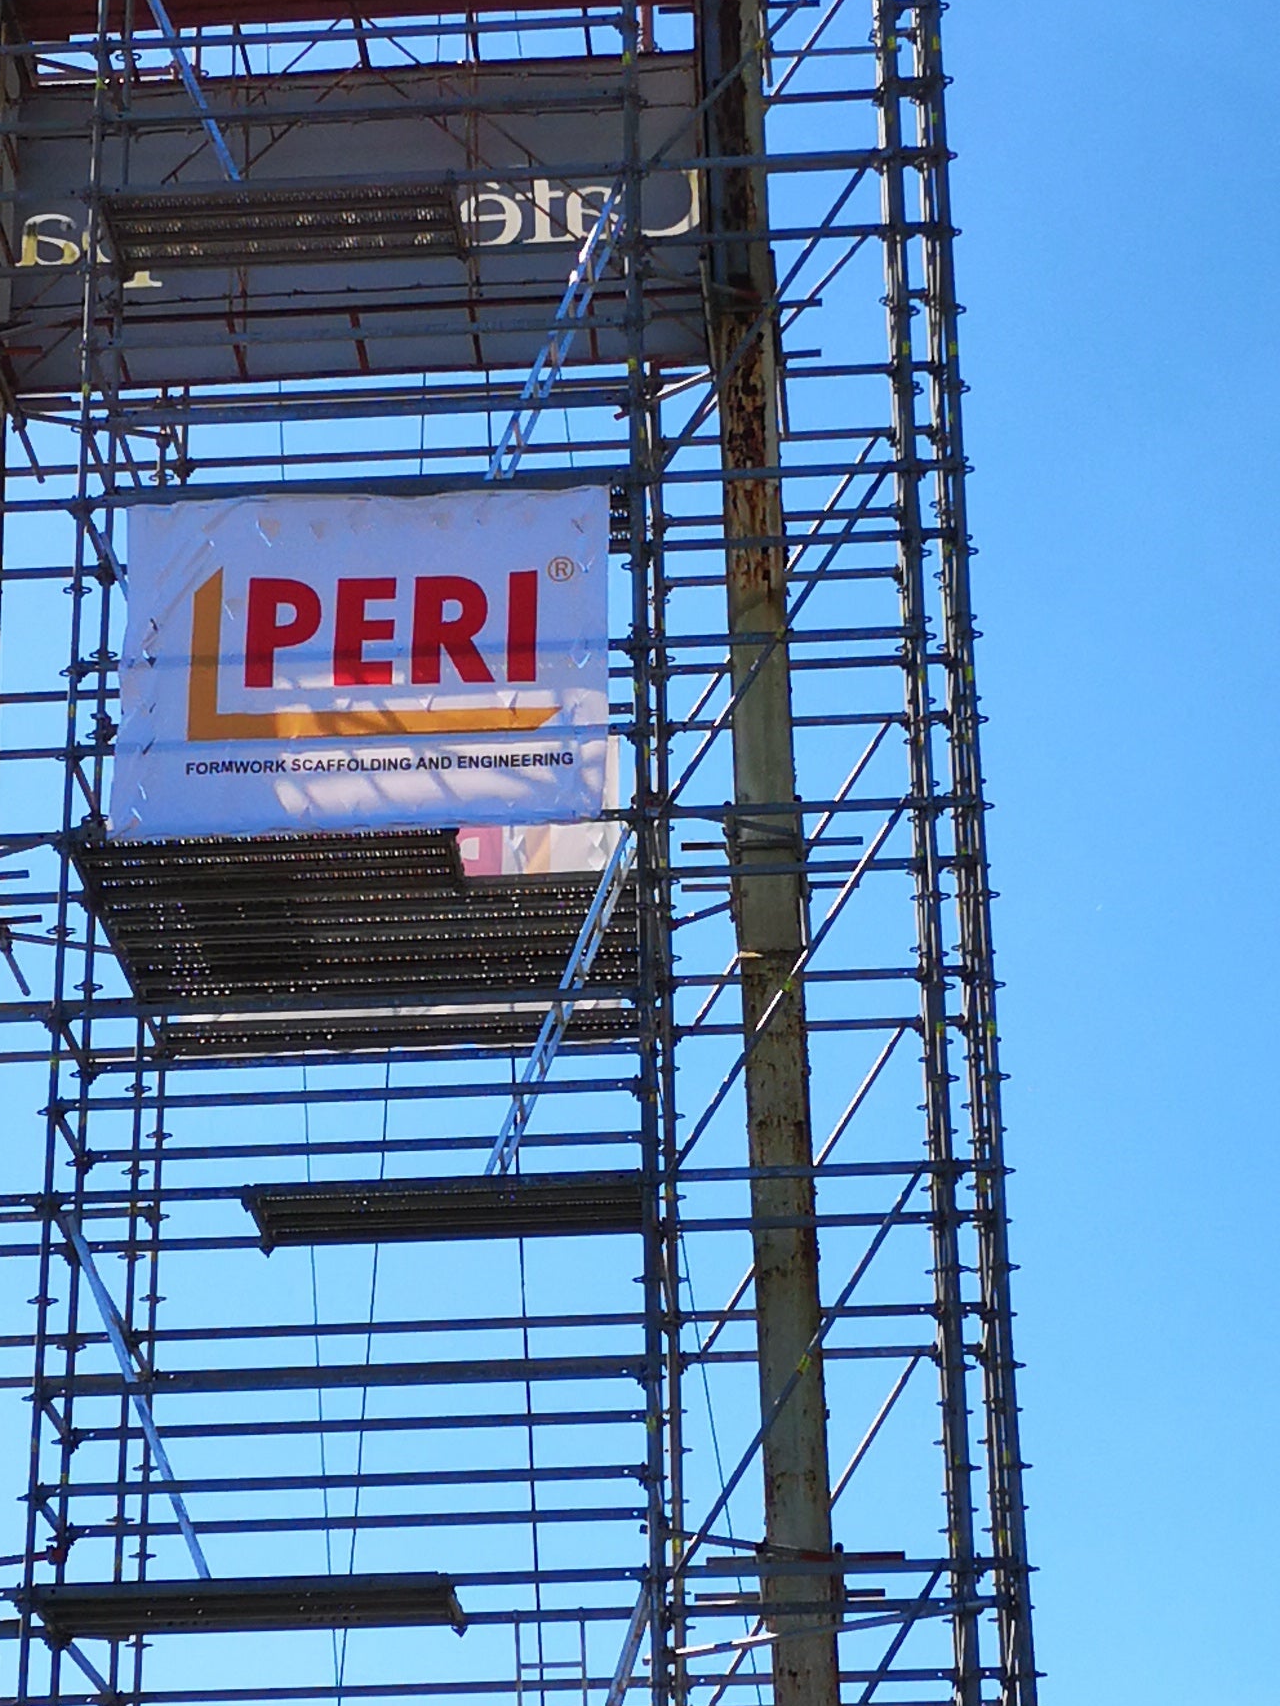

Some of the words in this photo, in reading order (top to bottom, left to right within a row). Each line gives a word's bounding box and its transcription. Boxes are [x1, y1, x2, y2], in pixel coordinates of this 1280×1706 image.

[244, 569, 538, 688] PERI
[185, 758, 287, 775] FORMWORK
[291, 756, 412, 773] SCAFFOLDING
[415, 756, 453, 771] AND
[457, 751, 574, 770] ENGINEERING
